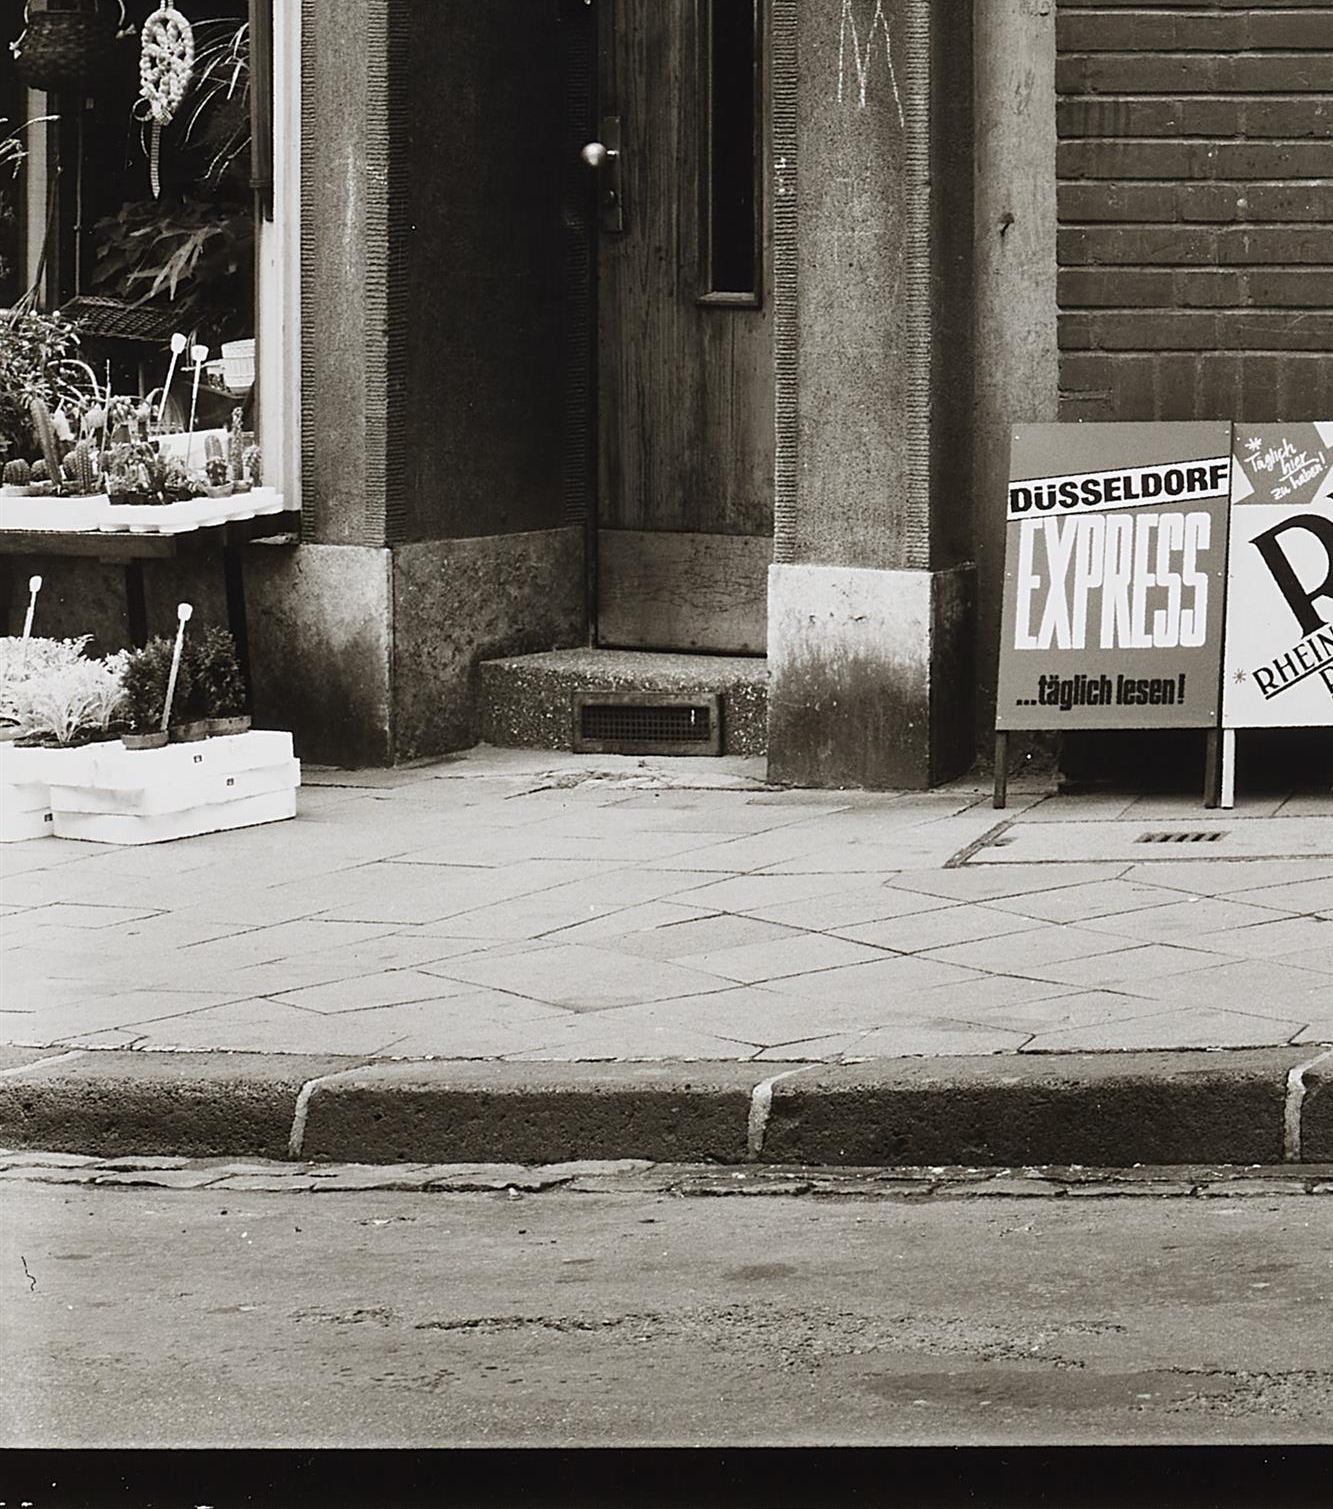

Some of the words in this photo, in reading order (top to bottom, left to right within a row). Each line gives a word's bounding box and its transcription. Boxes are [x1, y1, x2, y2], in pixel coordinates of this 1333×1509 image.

[1244, 438, 1297, 472] Täglich
[1270, 486, 1291, 500] zu
[1289, 452, 1328, 489] haben!
[1279, 452, 1307, 476] hier
[1009, 463, 1230, 513] DÜSSELDORF
[1014, 511, 1210, 650] EXPRESS
[1016, 674, 1112, 711] ...täglich
[1116, 673, 1186, 705] lesen!
